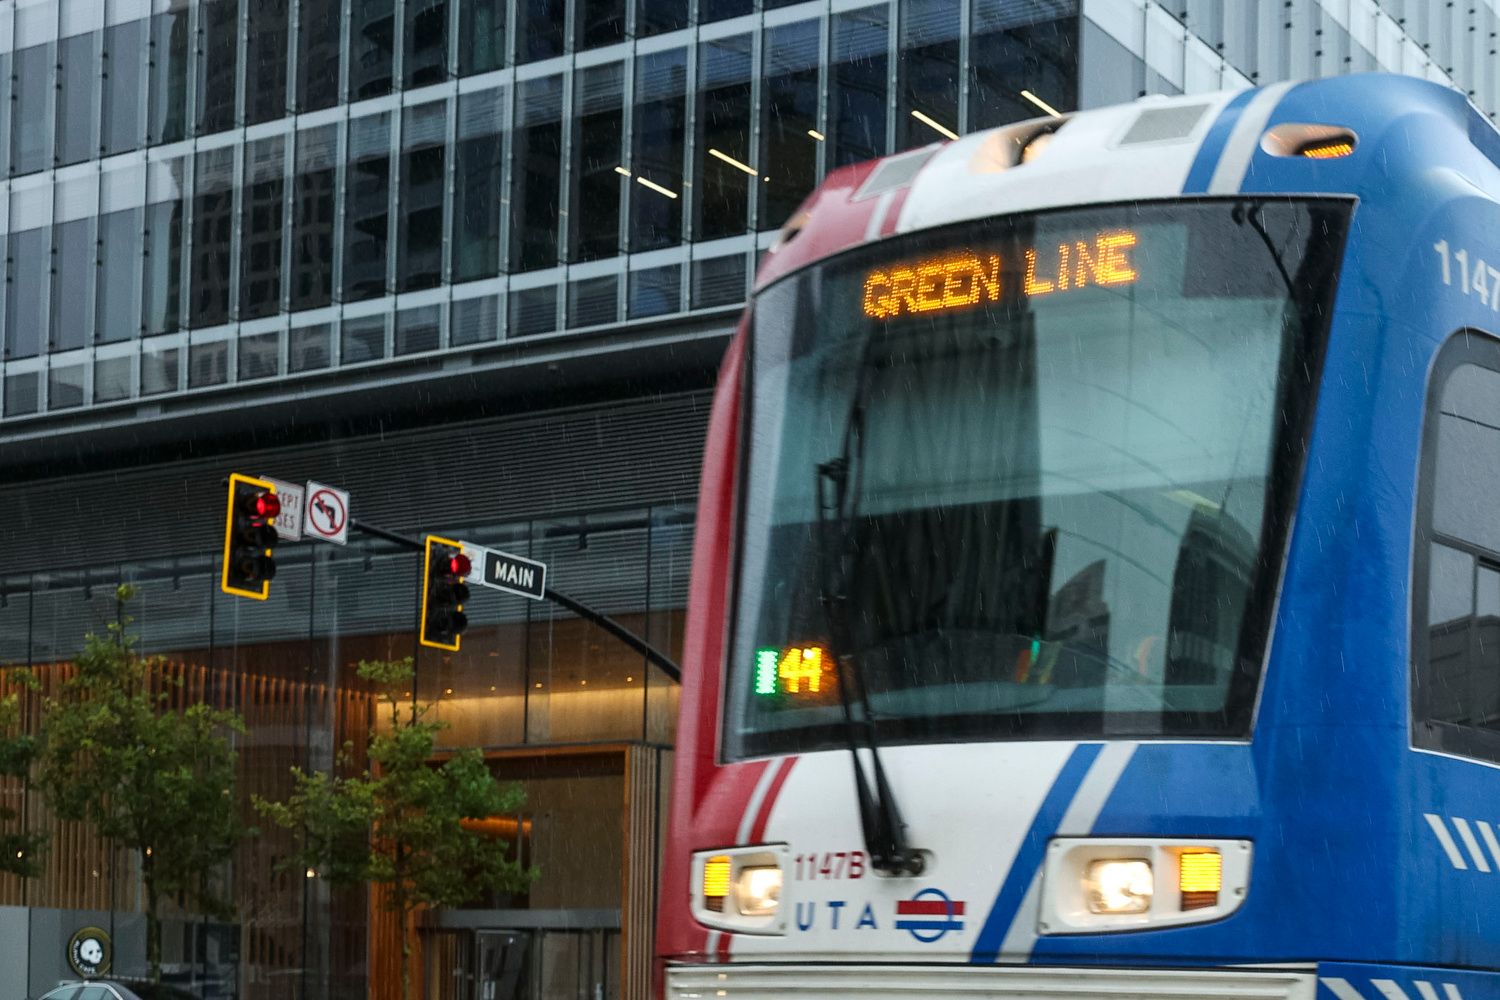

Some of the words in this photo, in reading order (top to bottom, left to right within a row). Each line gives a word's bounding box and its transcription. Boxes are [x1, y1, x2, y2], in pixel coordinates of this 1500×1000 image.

[863, 255, 1000, 318] GREEN
[1025, 231, 1137, 296] LINE
[494, 560, 535, 589] MAIN
[794, 851, 867, 881] 1147B
[796, 900, 880, 931] UTA
